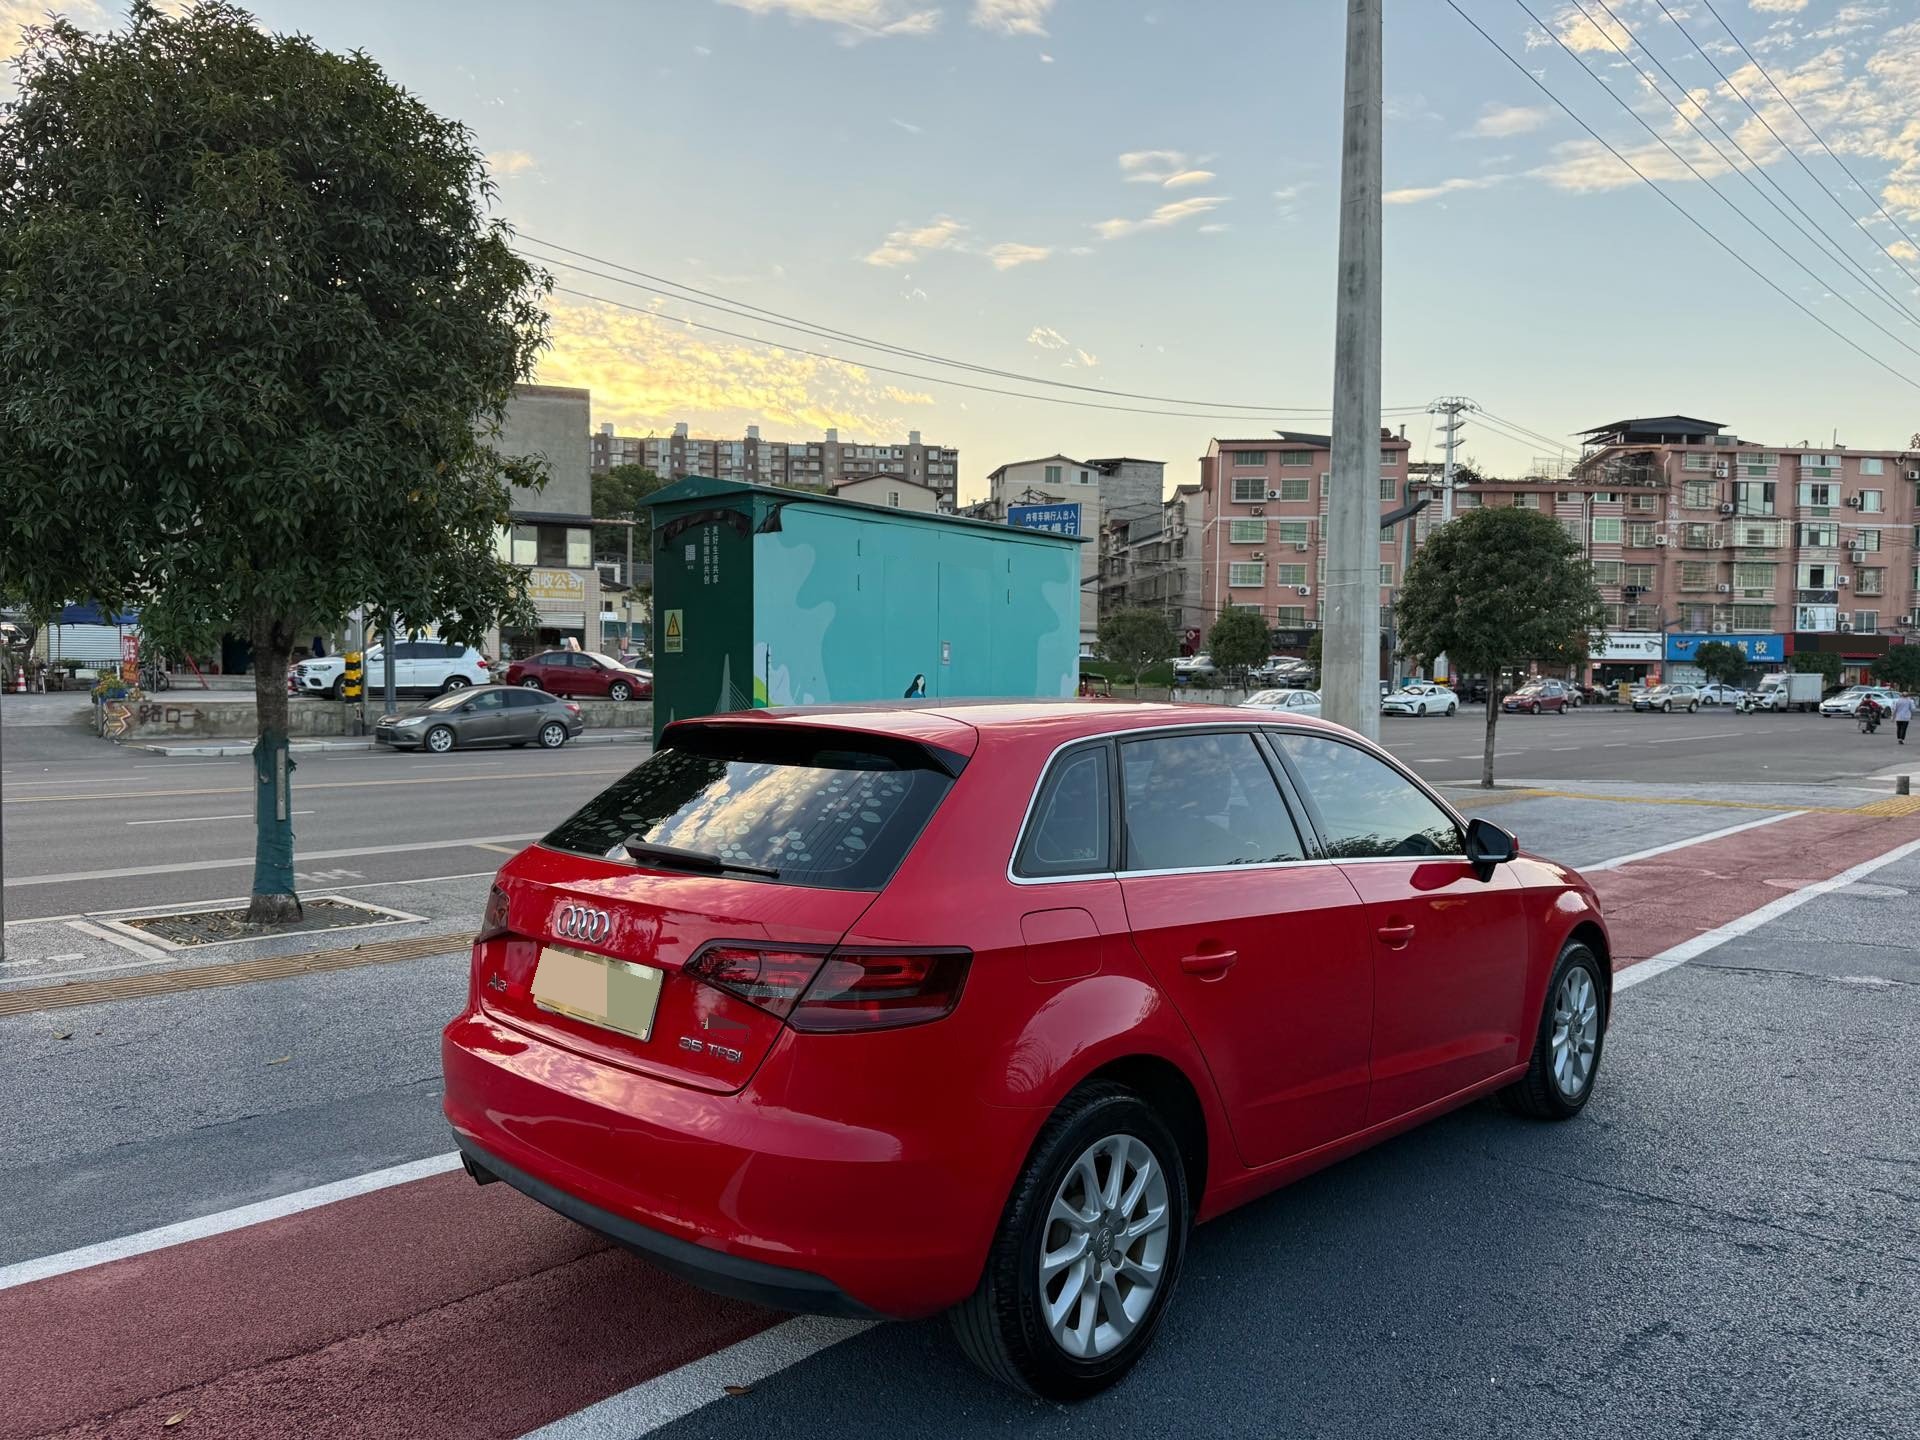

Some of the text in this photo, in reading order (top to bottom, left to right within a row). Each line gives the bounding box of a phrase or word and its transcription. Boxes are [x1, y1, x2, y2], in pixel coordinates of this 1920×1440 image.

[140, 704, 180, 724] 路口
[487, 972, 508, 993] A3
[678, 1036, 703, 1052] 35
